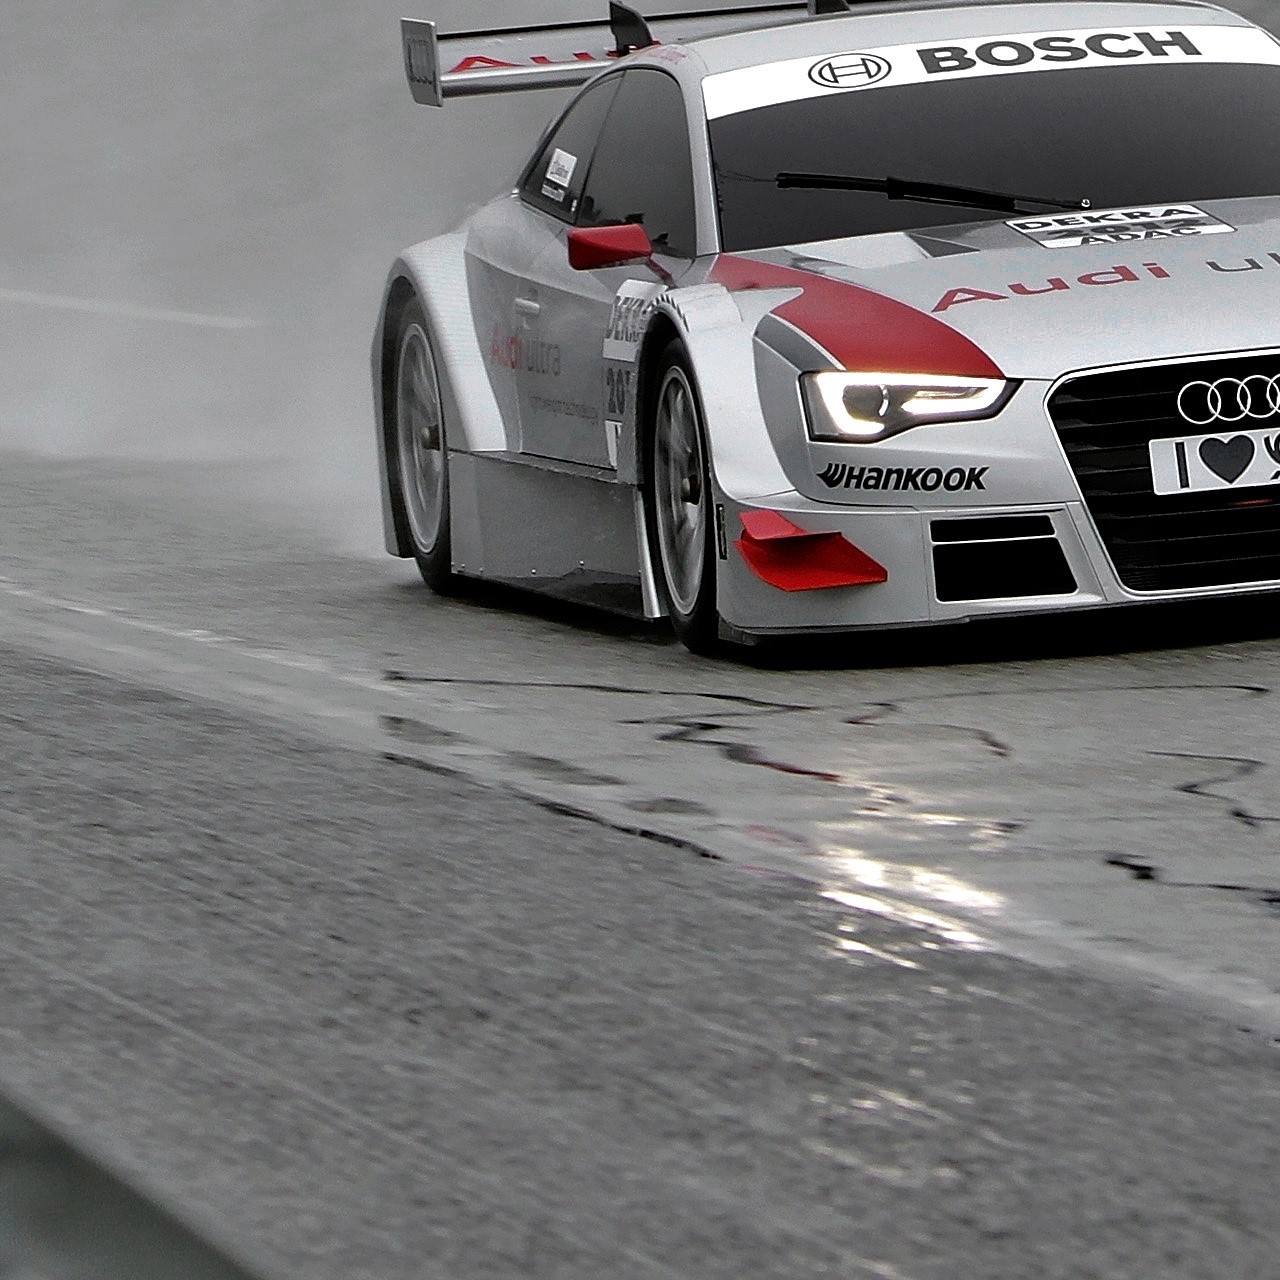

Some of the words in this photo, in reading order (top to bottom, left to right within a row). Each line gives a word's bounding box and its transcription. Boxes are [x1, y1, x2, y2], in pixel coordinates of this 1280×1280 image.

[917, 31, 1203, 74] BOSCH
[1012, 208, 1200, 230] DEKRA
[1047, 219, 1207, 239] 2012
[1080, 227, 1201, 245] ADAC
[931, 261, 1171, 312] Audi
